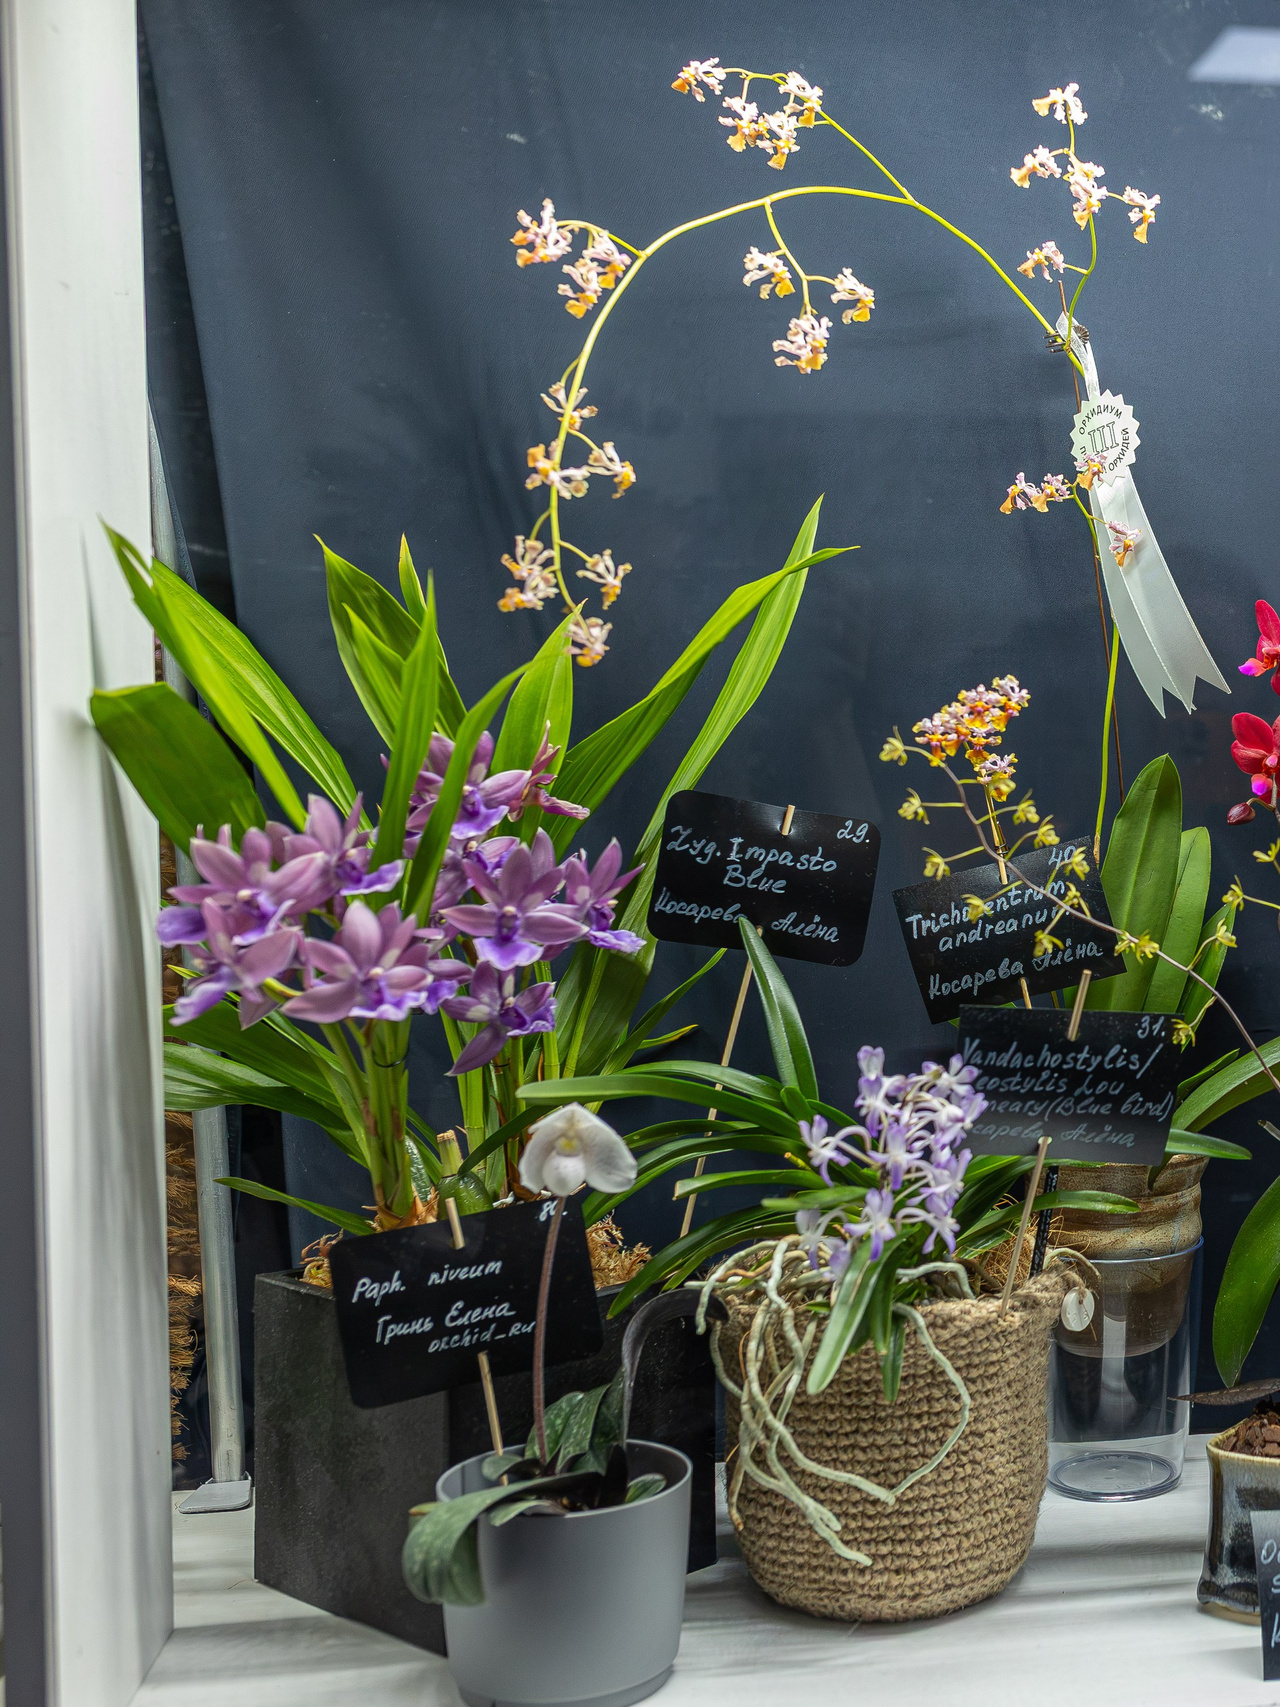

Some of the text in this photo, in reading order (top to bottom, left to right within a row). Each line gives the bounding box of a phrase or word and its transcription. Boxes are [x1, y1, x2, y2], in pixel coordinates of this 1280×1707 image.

[1079, 404, 1122, 435] ОРХИДИУМ
[1088, 421, 1119, 455] III
[1109, 427, 1130, 471] ОРХИДЕЙ
[837, 820, 870, 843] 29.
[666, 826, 837, 872] Zyg. Impasto
[723, 864, 787, 893] Blue
[905, 880, 1065, 939] Trichoentrum
[771, 911, 840, 943] Алёна
[928, 938, 1103, 1000] Косарева Алёна
[1137, 1015, 1165, 1039] 31.
[976, 1067, 1124, 1097] eostylis Lou
[972, 1122, 1135, 1148] сарева Алёна
[352, 1260, 502, 1307] Paph. niveum
[375, 1300, 516, 1346] Гринь Елена
